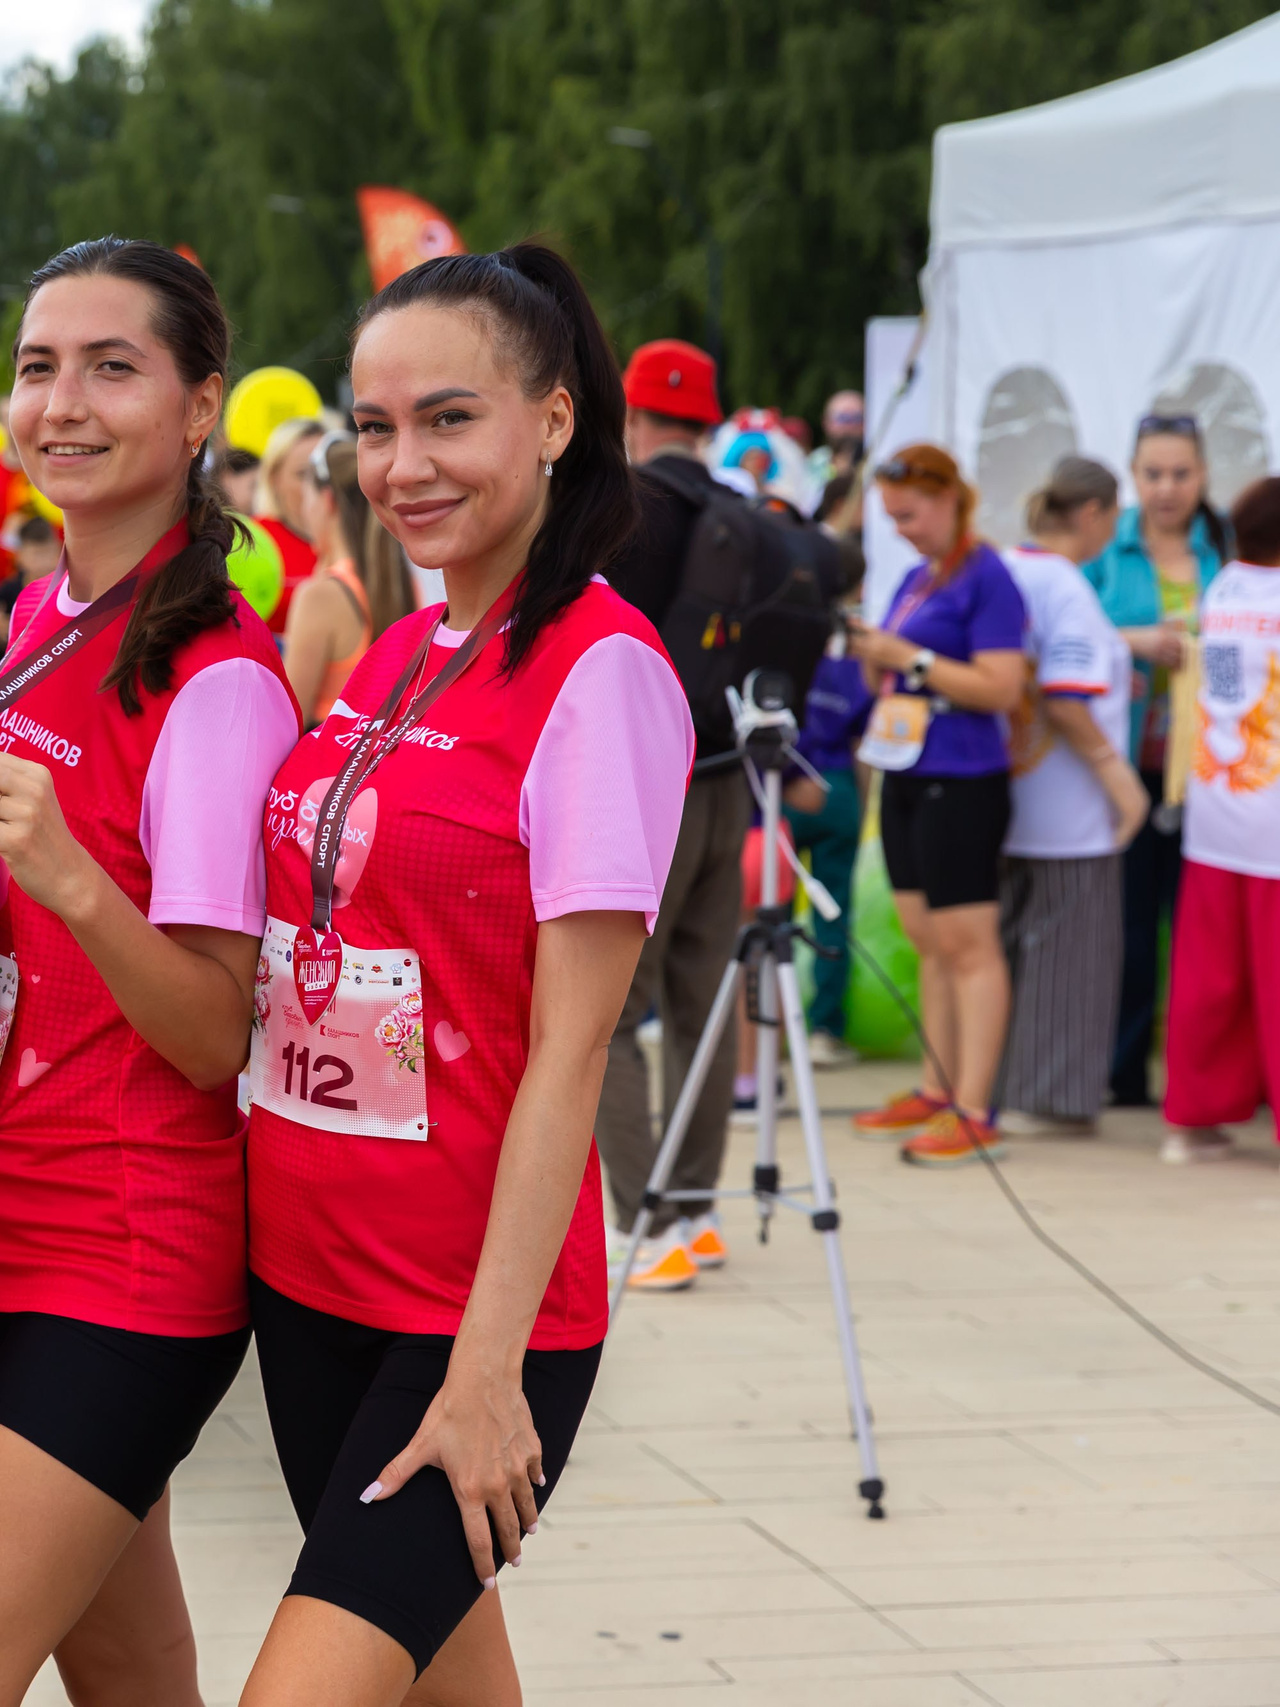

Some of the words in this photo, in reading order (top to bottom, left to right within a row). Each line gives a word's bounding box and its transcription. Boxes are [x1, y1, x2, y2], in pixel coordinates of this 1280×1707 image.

[50, 628, 83, 657] СПОРТ
[326, 738, 372, 820] КАЛАШНИКОВ
[269, 786, 299, 811] луб
[317, 824, 332, 868] СПОРТ
[298, 960, 336, 984] ЖЕНСКИЙ
[327, 1027, 360, 1038] КАЛАШНИКОВ
[282, 1040, 358, 1111] 112
